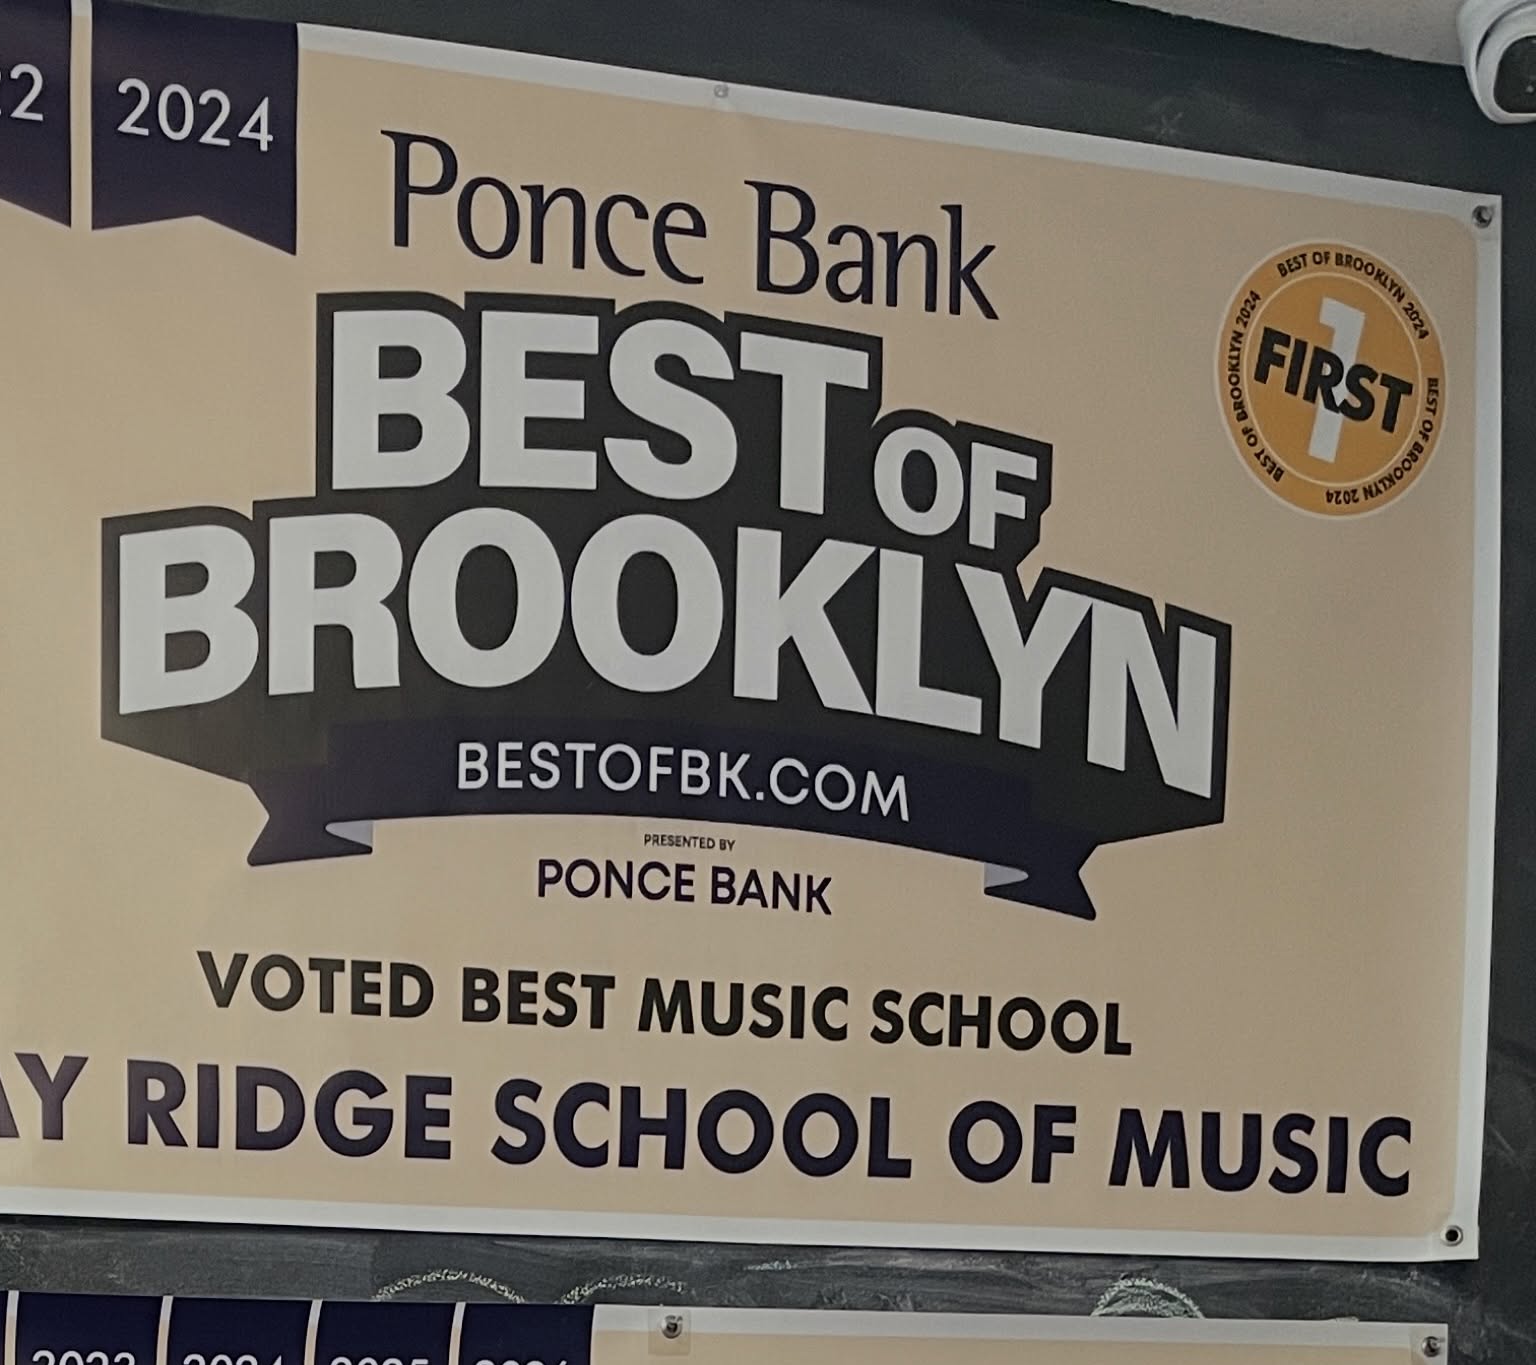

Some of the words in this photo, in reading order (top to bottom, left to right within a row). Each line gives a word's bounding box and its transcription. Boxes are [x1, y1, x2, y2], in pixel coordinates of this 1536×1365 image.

[117, 78, 274, 153] 2024
[380, 130, 707, 286] Ponce
[743, 180, 1000, 321] Bank
[1235, 290, 1262, 328] 2024
[1277, 253, 1307, 278] BEST
[1313, 251, 1331, 265] OF
[1335, 252, 1406, 303] BROOKLYN
[1402, 302, 1430, 340] 2024
[1228, 330, 1249, 423] BROOKLYN
[1253, 325, 1413, 434] FIRST
[1427, 377, 1439, 417] BEST
[332, 306, 870, 515] BEST
[874, 425, 1039, 548] OF
[1241, 426, 1258, 447] OF
[1253, 448, 1285, 483] BEST
[1325, 488, 1360, 505] 2024
[1363, 439, 1425, 501] BROOKLYN
[118, 505, 1219, 801] BROOKLYN
[457, 741, 910, 823] BESTOFBK.COM
[644, 833, 716, 850] PRESENTED
[719, 839, 736, 851] BY
[537, 859, 696, 904] PONCE
[711, 868, 833, 915] BANK
[196, 951, 433, 1019] VOTED
[462, 969, 616, 1031] BEST
[638, 977, 849, 1042] MUSIC
[869, 988, 1133, 1057] SCHOOL
[126, 1059, 453, 1161] RIDGE
[490, 1077, 913, 1181] SCHOOL
[948, 1099, 1078, 1186] OF
[1108, 1106, 1413, 1199] MUSIC
